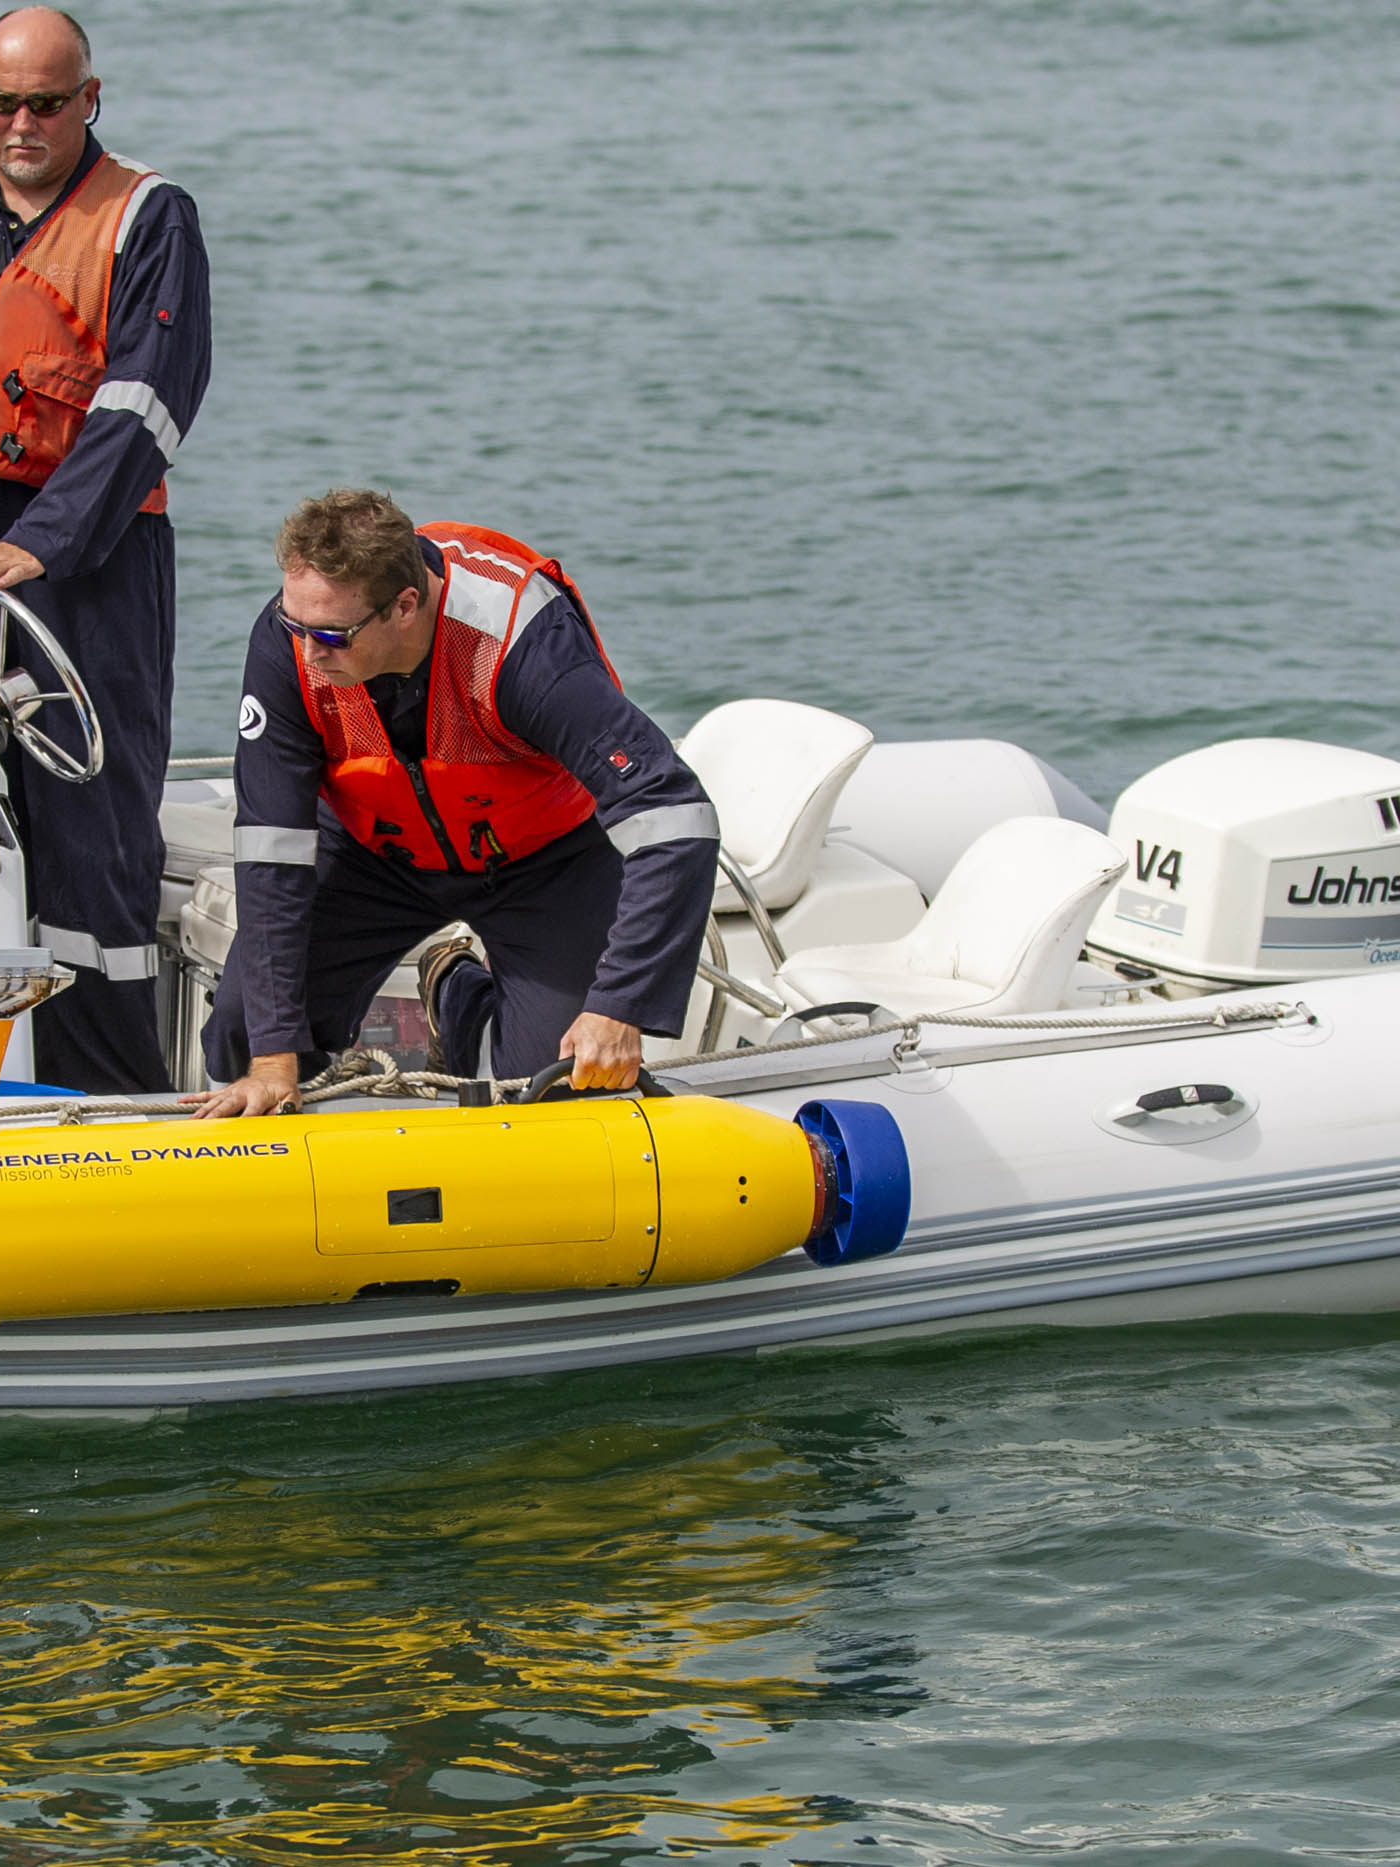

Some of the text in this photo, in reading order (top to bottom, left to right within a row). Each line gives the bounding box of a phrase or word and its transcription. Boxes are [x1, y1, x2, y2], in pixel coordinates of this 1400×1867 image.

[1136, 839, 1184, 891] V4
[130, 1143, 290, 1162] DYNAMICS
[58, 1162, 133, 1181] Systems
